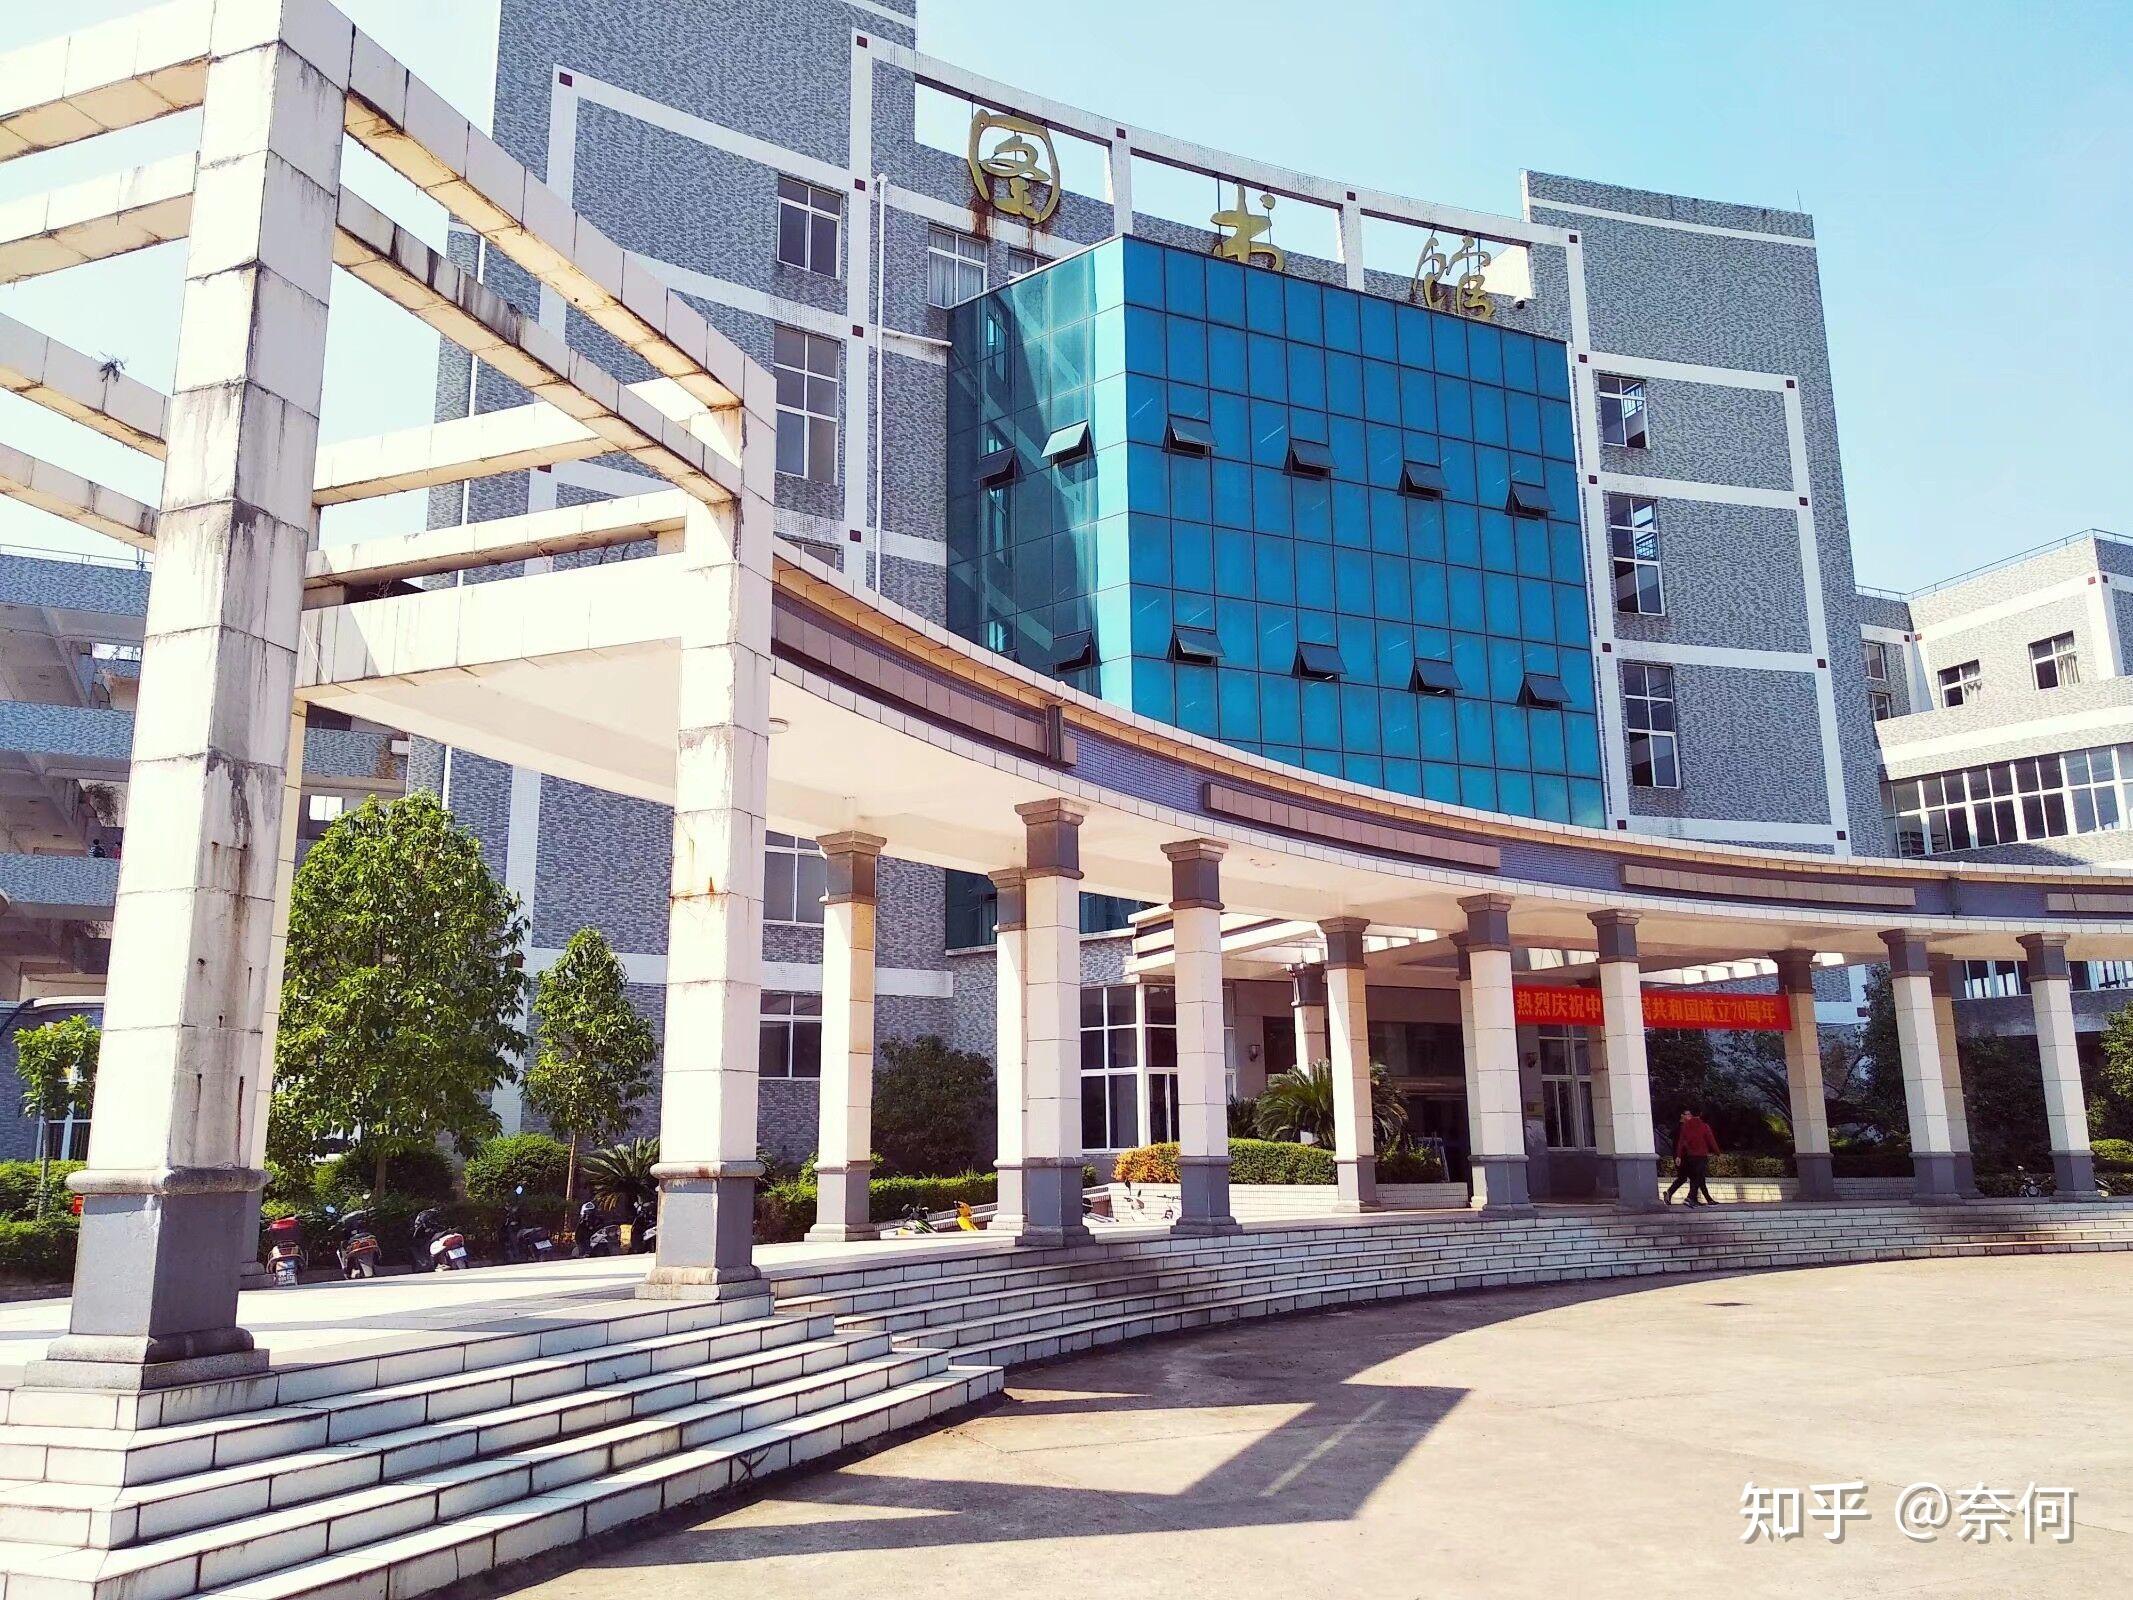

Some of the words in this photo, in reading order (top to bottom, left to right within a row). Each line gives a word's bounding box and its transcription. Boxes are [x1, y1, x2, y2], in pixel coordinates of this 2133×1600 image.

[1516, 990, 1777, 1023] 热烈庆祝中民共和国成立70周年
